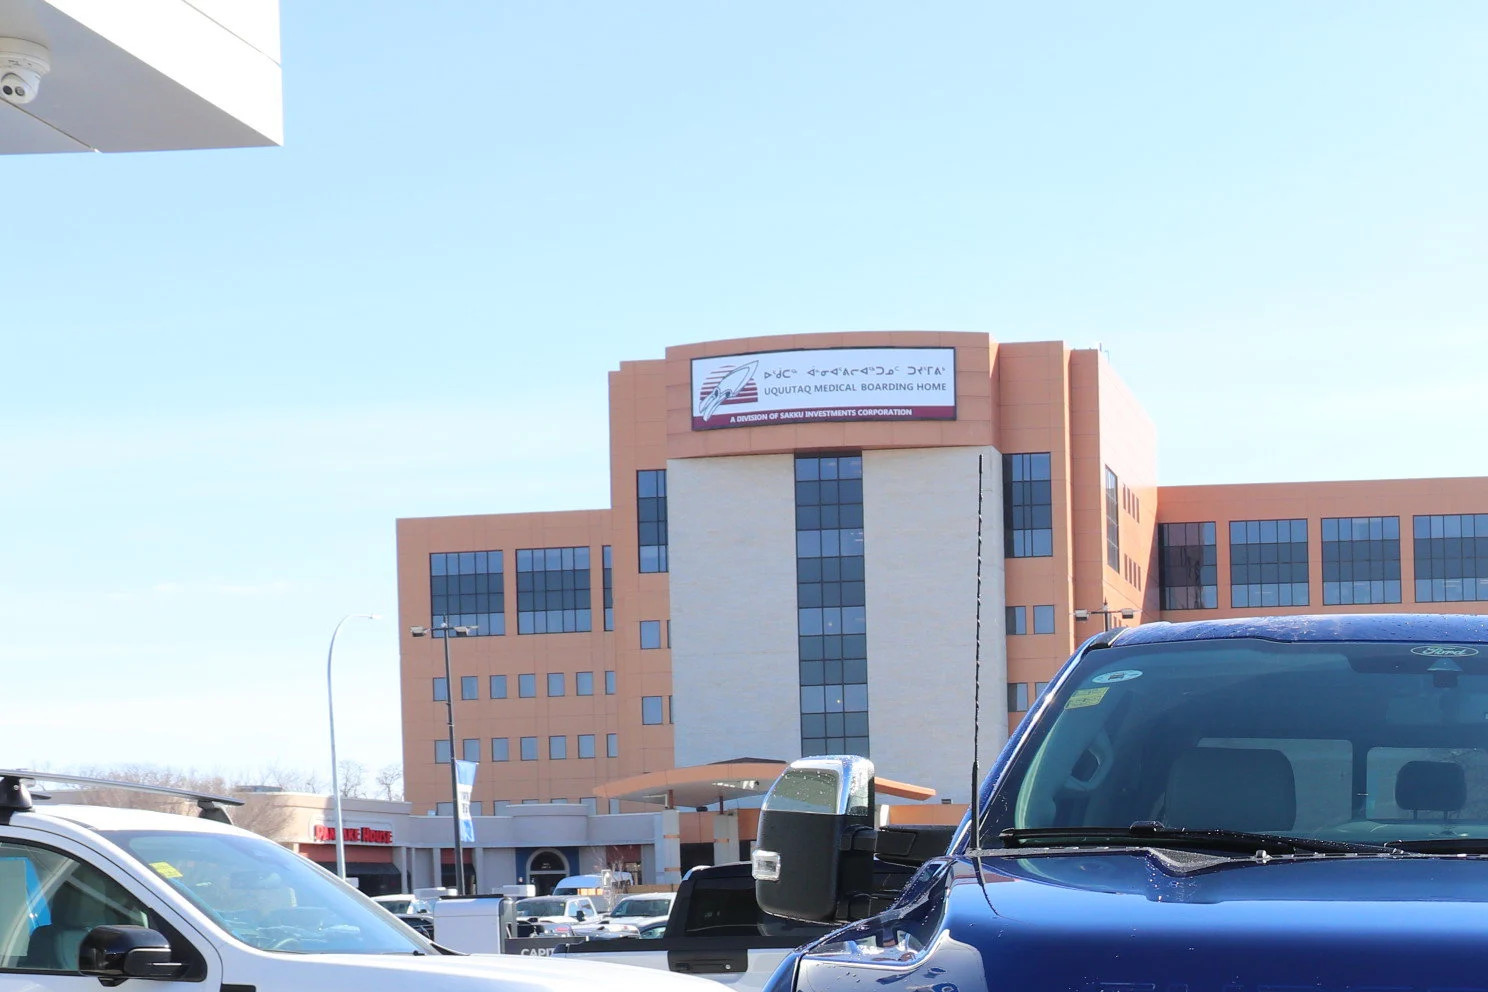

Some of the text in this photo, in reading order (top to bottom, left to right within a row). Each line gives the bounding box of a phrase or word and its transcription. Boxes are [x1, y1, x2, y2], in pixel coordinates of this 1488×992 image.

[764, 382, 946, 396] UQUUTAQ MEDICAL BOARDING HOME
[737, 414, 767, 422] DIVISION
[780, 411, 803, 419] SAKKU
[805, 409, 856, 417] INVESTMENTS
[1422, 646, 1466, 656] Ford
[314, 825, 393, 844] PANAKE HOUSE
